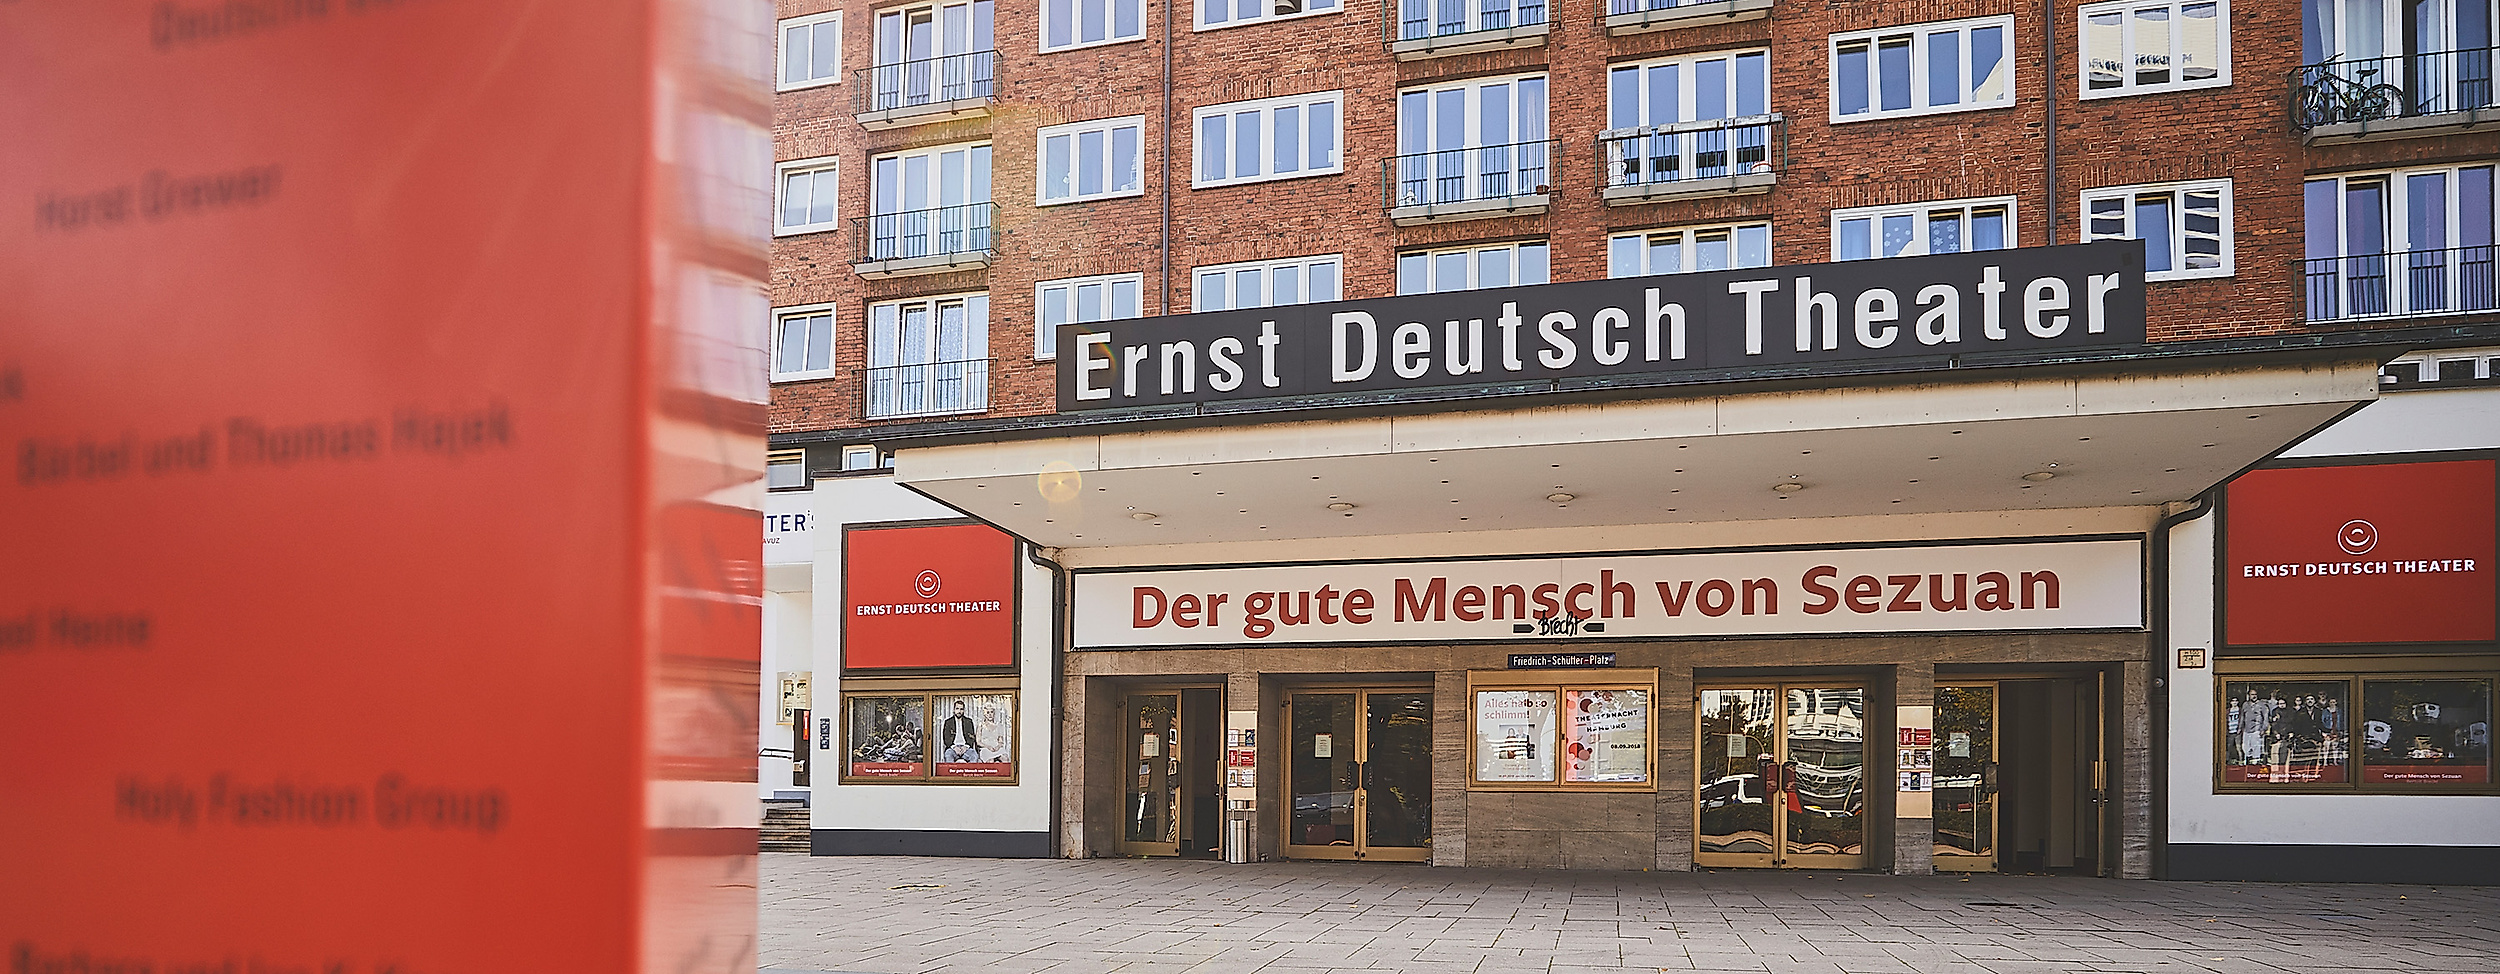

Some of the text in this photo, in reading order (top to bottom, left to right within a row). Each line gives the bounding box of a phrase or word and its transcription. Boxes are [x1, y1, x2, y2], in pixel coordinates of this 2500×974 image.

[1075, 265, 2121, 402] Ernst Deutsch Theater
[143, 427, 214, 477] und
[227, 415, 380, 466] Thomas
[2243, 559, 2476, 577] ERNST DEUTSCH THEATER
[856, 601, 1001, 616] ERNST DEUTSCH THEATER
[1132, 565, 2061, 639] Der gute Mensch von Sezuan
[1538, 610, 1584, 637] Brecht
[1513, 655, 1609, 667] Friedrich-Schütter-Platz
[1484, 699, 1508, 708] Alles
[1484, 710, 1530, 720] schlimm!
[115, 771, 511, 839] Holy Fashion Group
